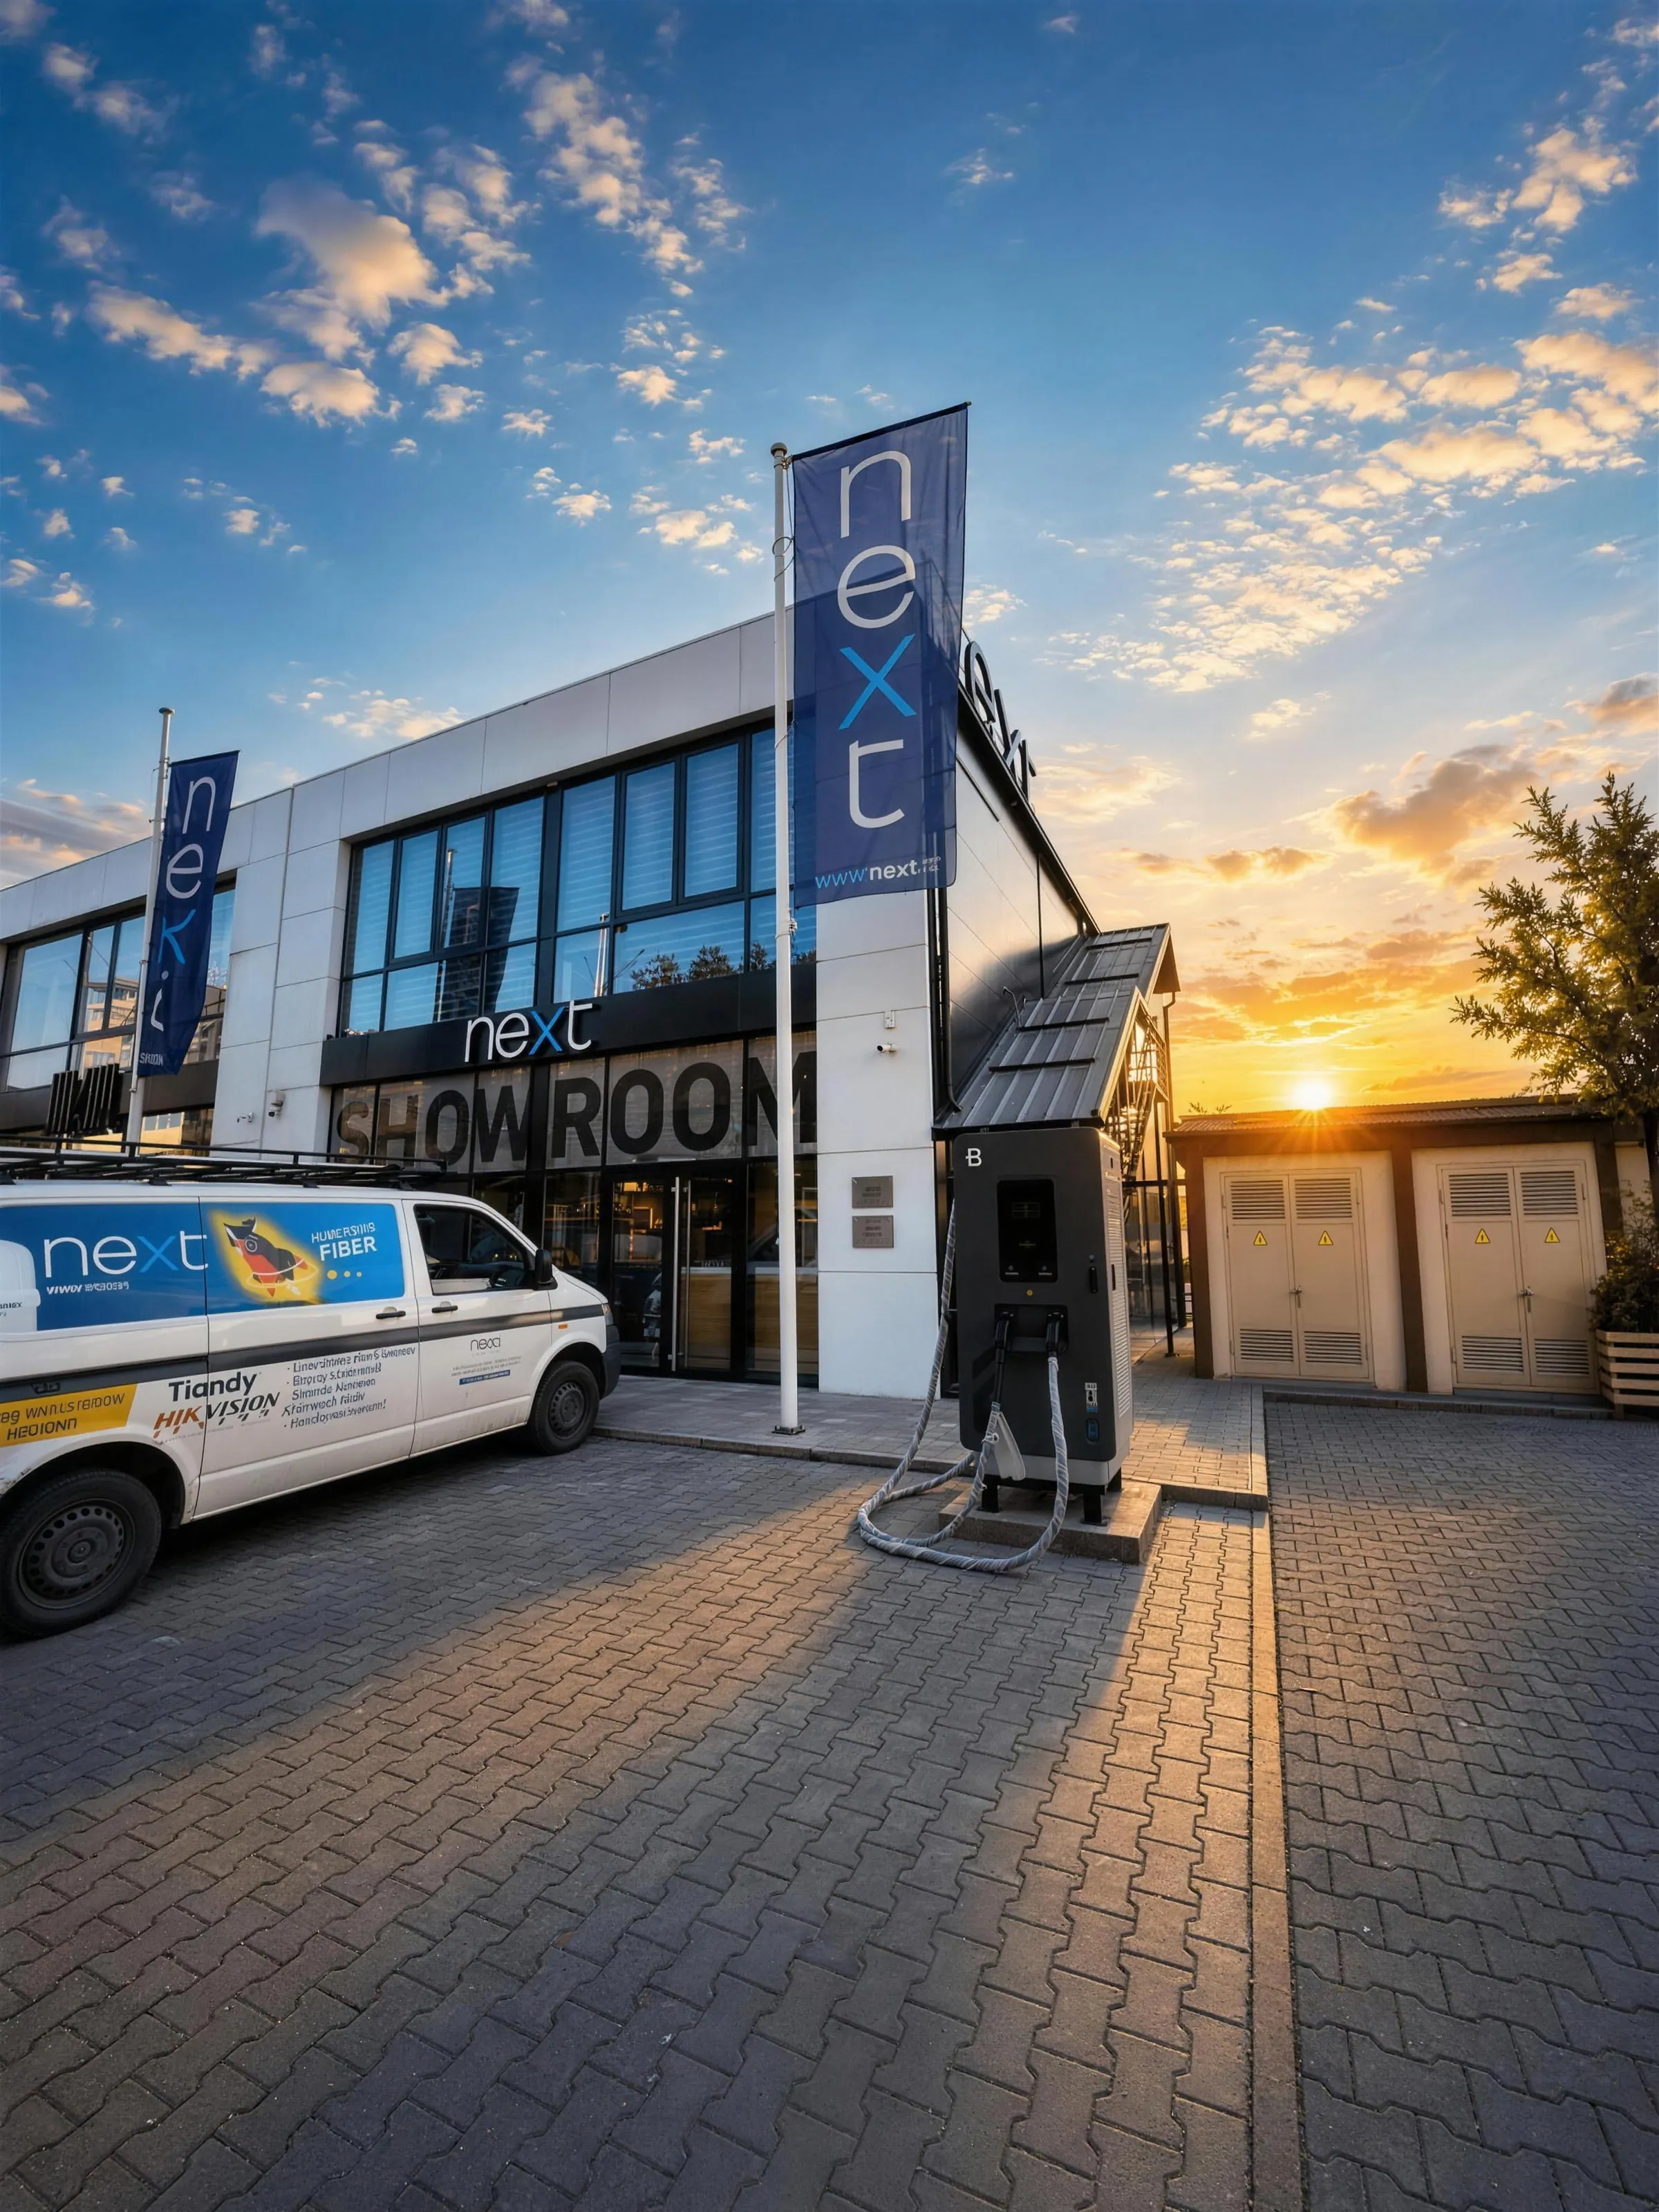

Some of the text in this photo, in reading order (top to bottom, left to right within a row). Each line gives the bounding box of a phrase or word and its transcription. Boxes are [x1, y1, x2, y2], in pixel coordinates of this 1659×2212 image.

[837, 451, 917, 829] next
[465, 999, 594, 1062] next
[44, 1230, 209, 1278] next
[319, 1236, 377, 1262] FIBER
[169, 1371, 258, 1402] Tiandy
[153, 1391, 281, 1430] HIKVISION
